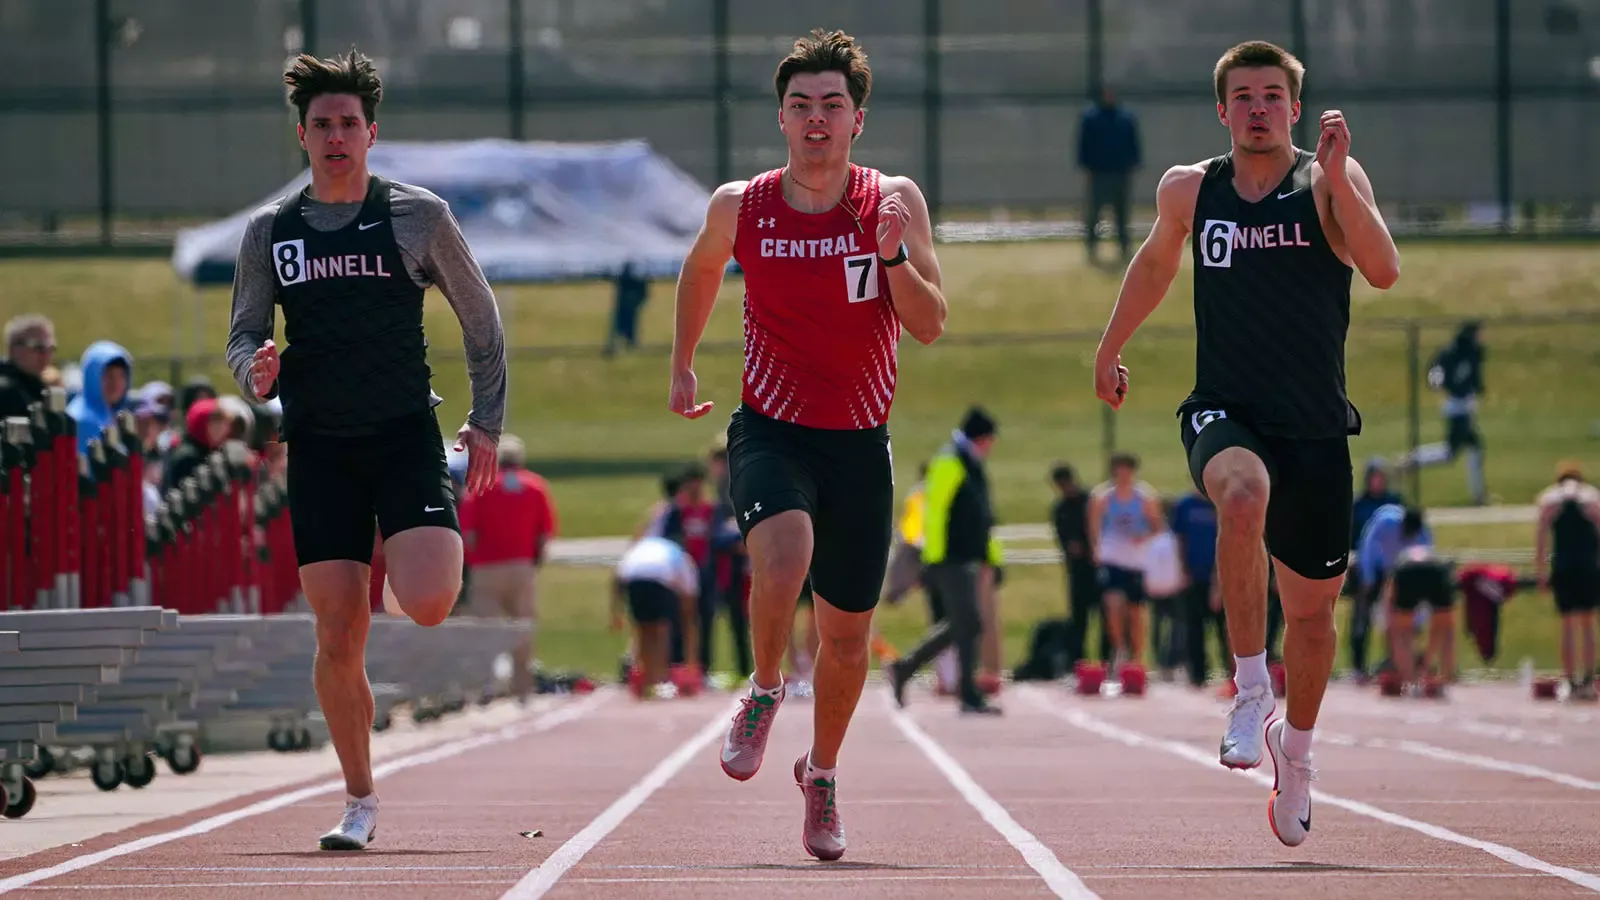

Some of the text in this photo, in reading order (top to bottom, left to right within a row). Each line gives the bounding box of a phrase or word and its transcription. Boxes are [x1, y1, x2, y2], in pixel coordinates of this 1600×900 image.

[760, 232, 860, 258] CENTRAL
[1206, 222, 1230, 264] 6
[1232, 223, 1311, 250] NNELL
[277, 243, 301, 282] 8
[305, 254, 391, 281] INNELL
[847, 257, 873, 299] 7
